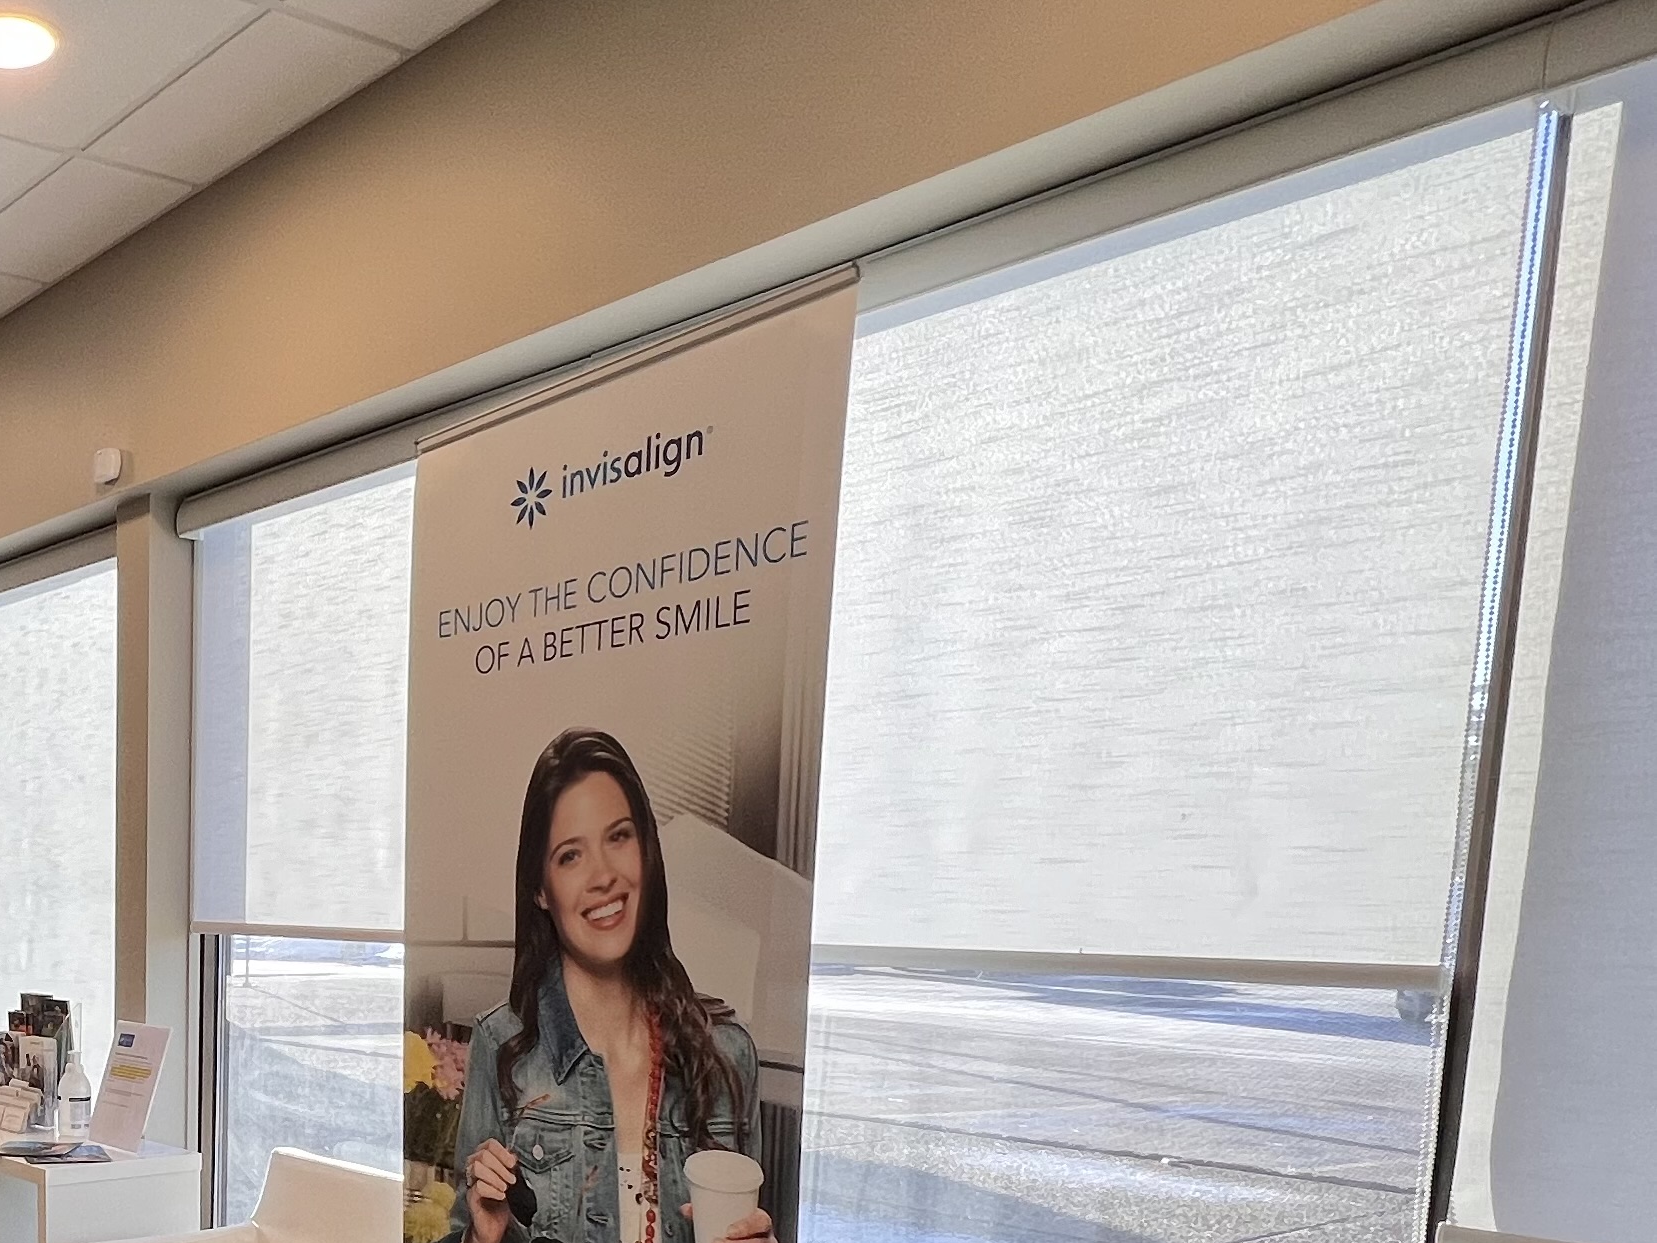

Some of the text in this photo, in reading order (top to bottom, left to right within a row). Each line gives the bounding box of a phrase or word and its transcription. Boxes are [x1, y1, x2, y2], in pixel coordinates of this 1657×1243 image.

[562, 430, 704, 499] invisalign
[438, 520, 810, 638] ENJOY THE CONFIDENCE
[475, 589, 752, 675] OF A BETTER SMILE
